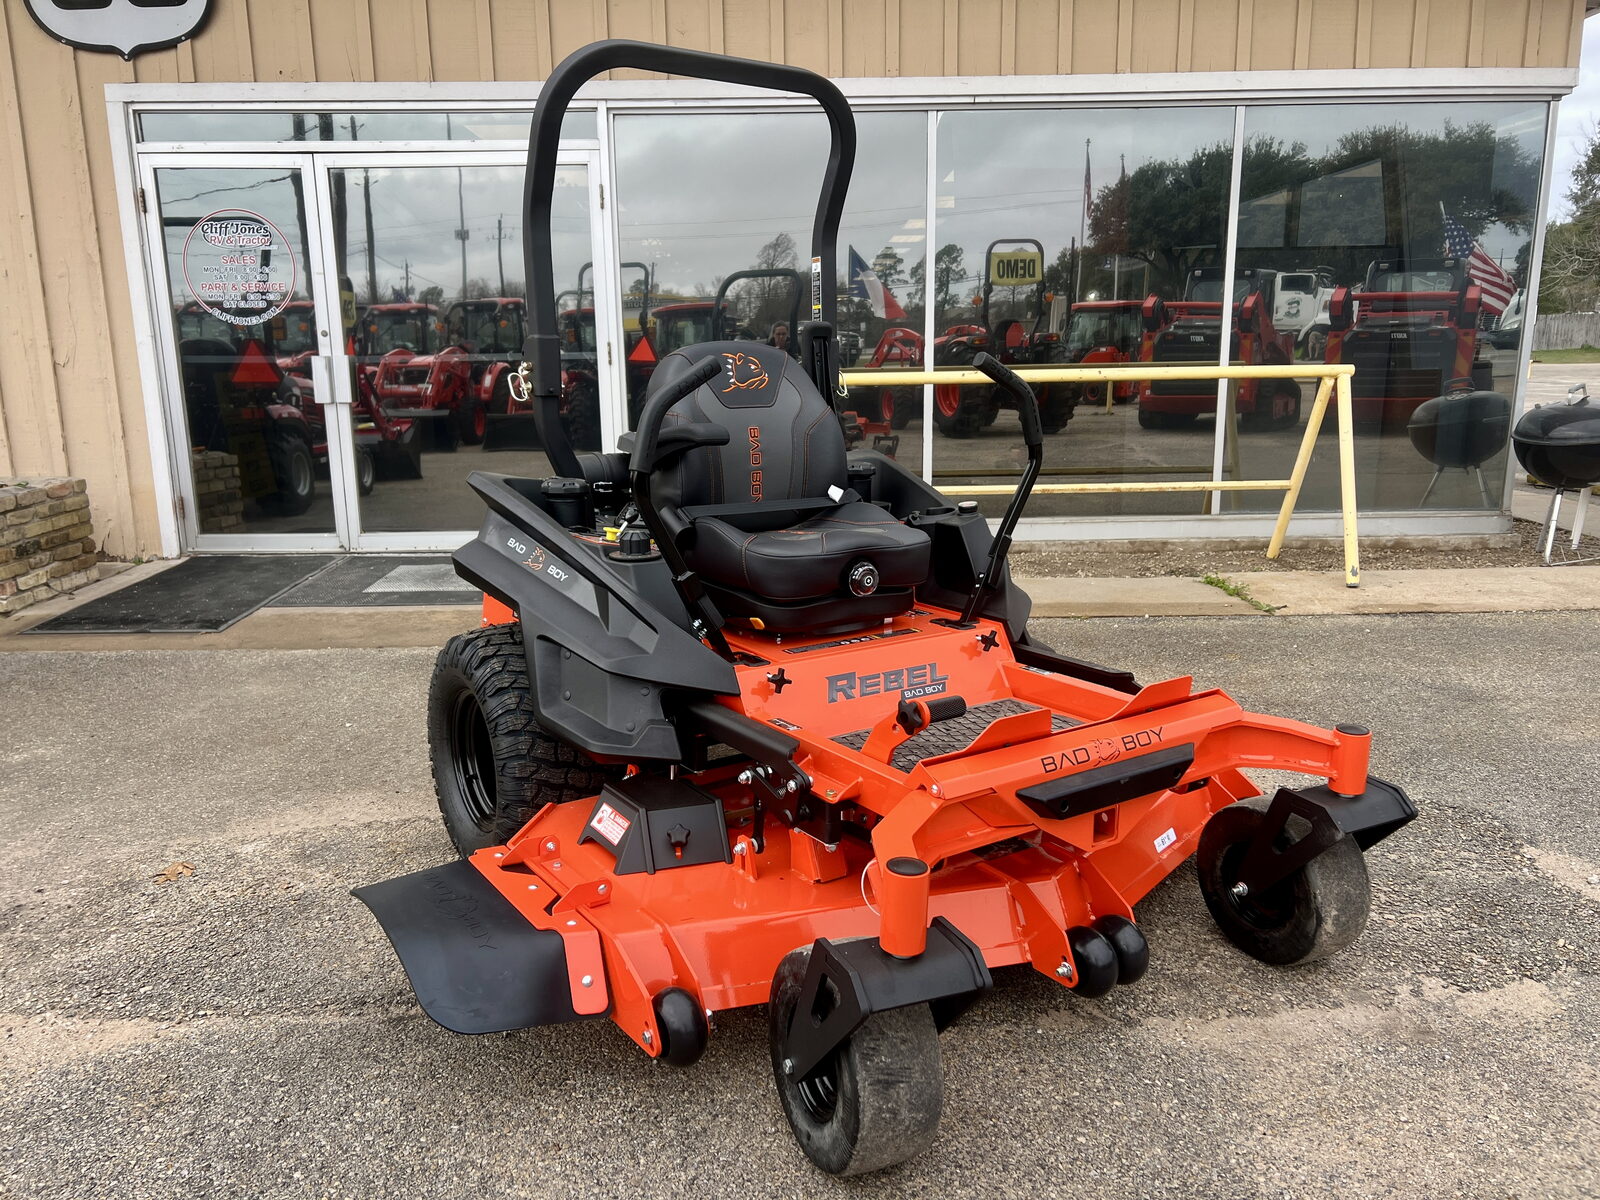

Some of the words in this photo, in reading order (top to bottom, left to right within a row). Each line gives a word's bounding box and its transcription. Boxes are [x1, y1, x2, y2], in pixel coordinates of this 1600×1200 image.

[202, 222, 229, 236] Cliff
[232, 223, 269, 234] Jones
[210, 235, 224, 245] RV
[226, 236, 234, 245] &
[237, 235, 271, 245] Tractor
[222, 256, 256, 265] SALES
[201, 283, 227, 291] PART
[231, 283, 238, 291] &
[241, 283, 285, 292] SERVICE
[211, 307, 279, 325] CLIFFJONES.COM
[748, 426, 762, 467] BAD
[507, 537, 526, 554] BAD
[547, 564, 569, 582] BOY
[825, 662, 950, 704] REBEL
[904, 688, 924, 699] BAD
[924, 684, 943, 695] BOY
[1040, 747, 1091, 774] BAD
[1121, 726, 1163, 752] BOY
